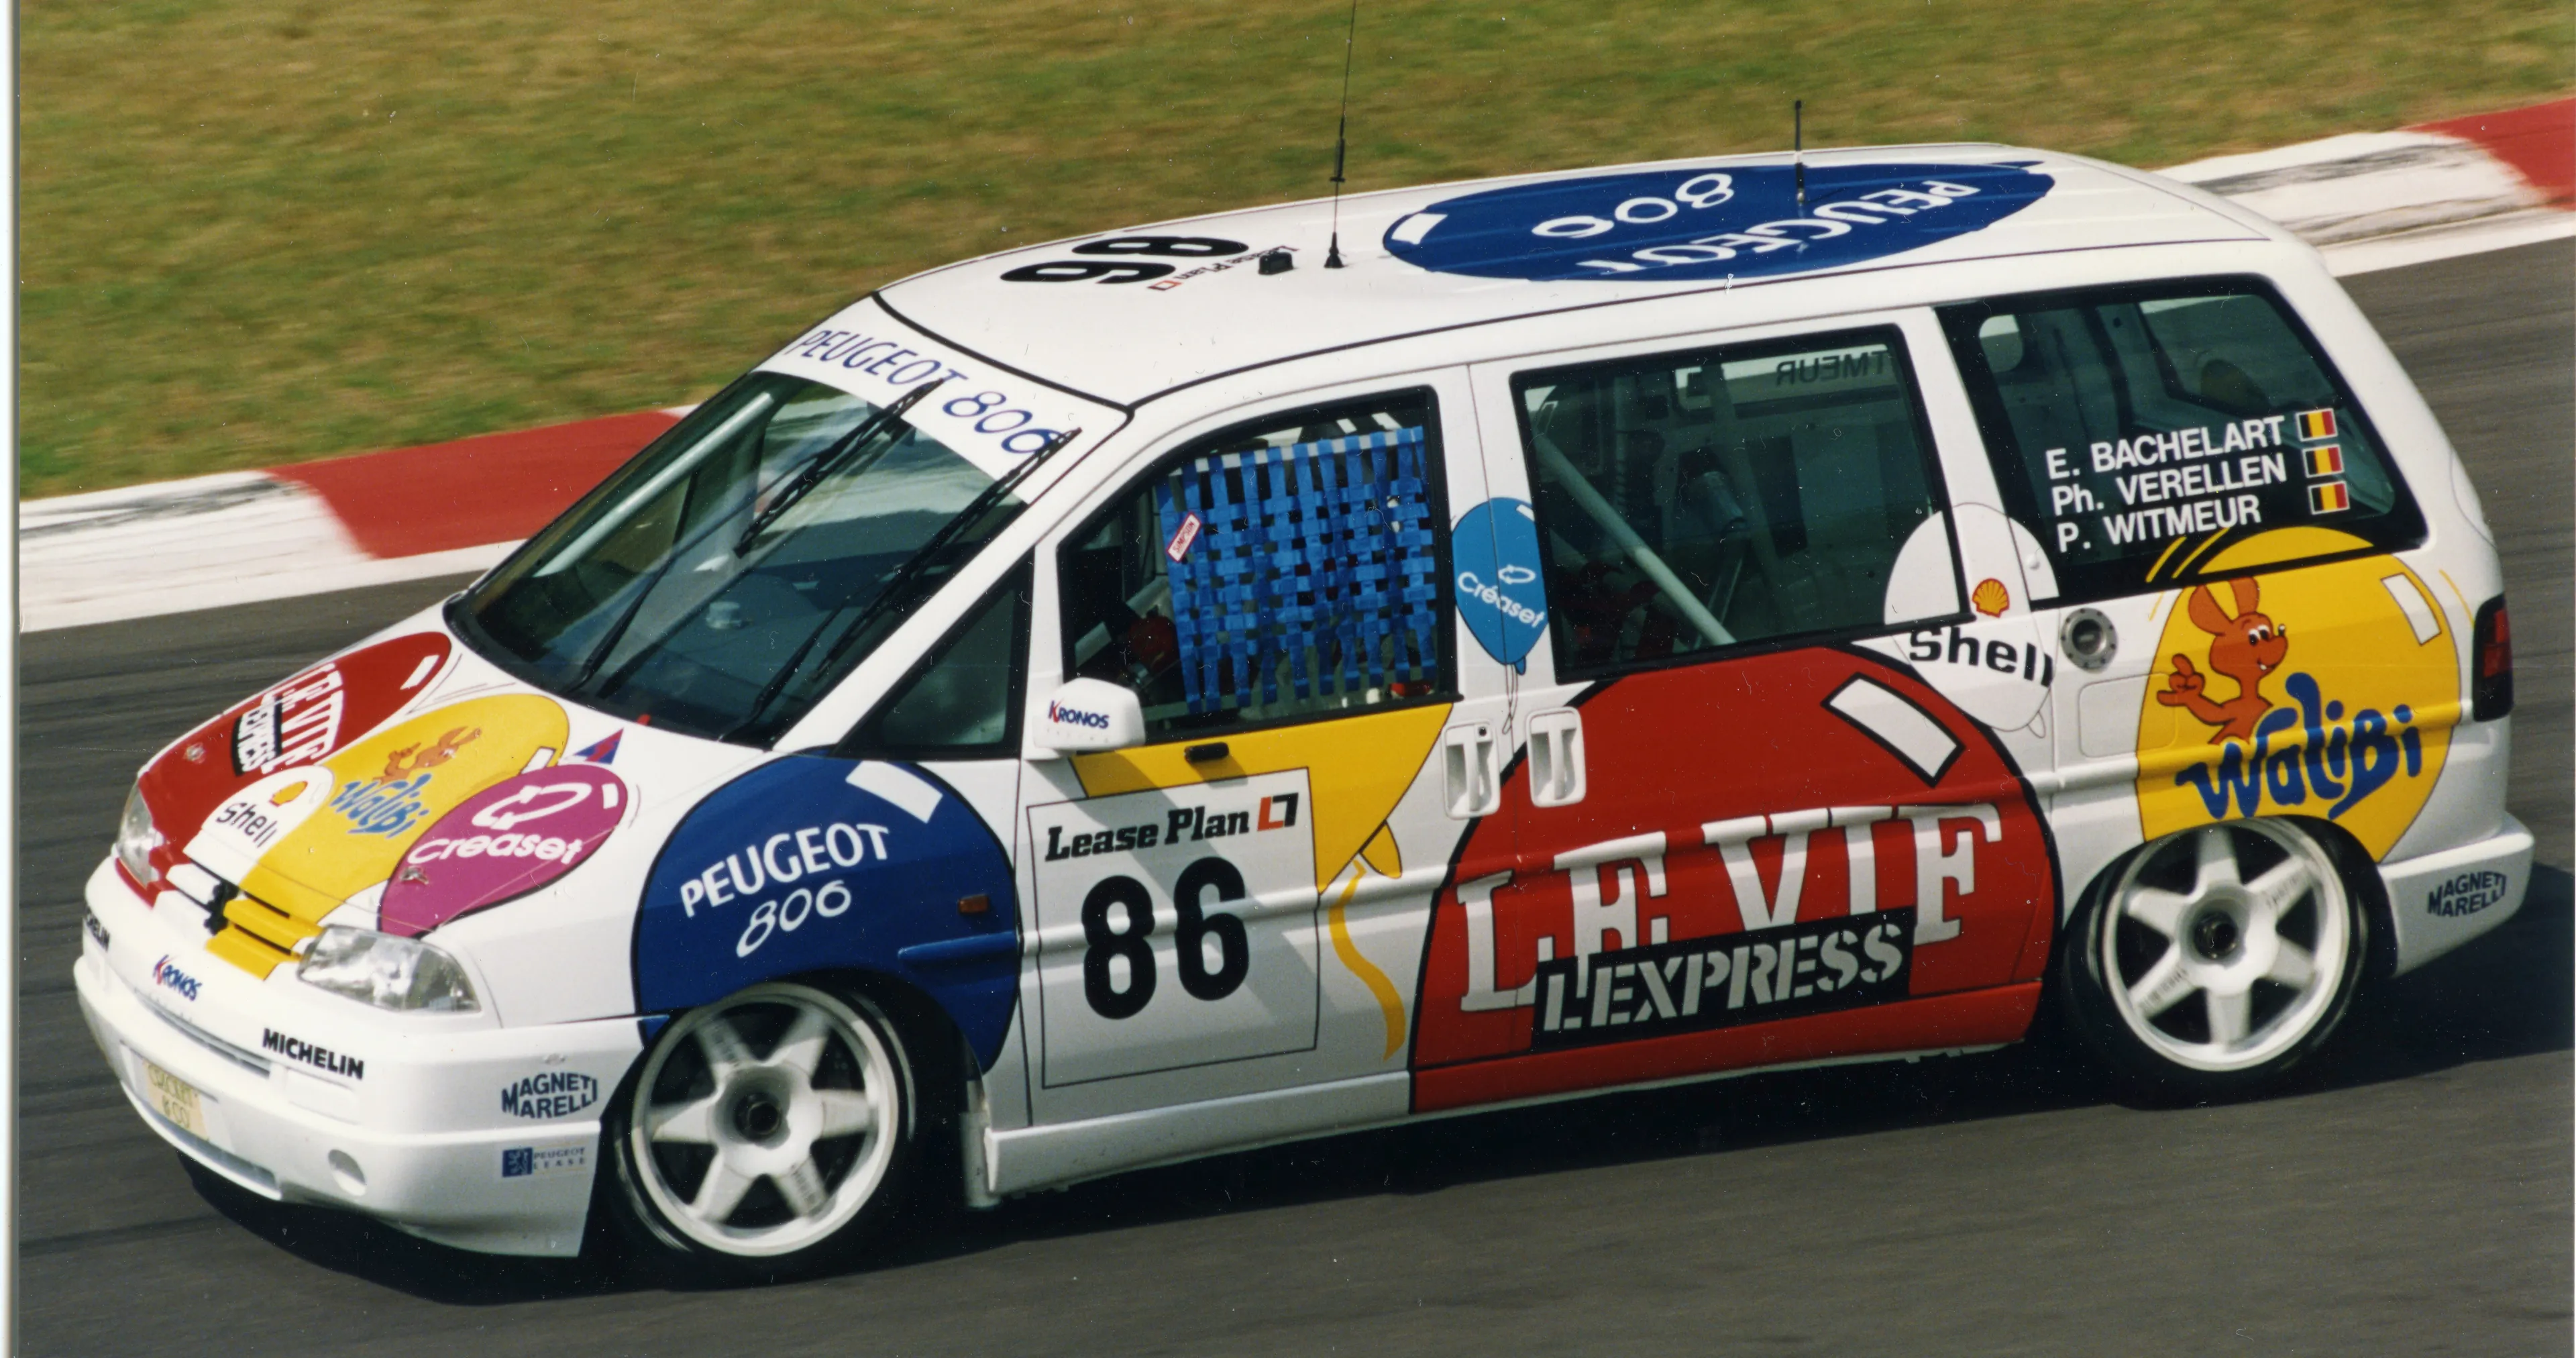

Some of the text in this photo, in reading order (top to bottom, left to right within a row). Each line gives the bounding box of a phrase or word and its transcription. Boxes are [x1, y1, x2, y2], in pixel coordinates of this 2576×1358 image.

[1532, 173, 1734, 239] 806
[784, 329, 1068, 454] PEUGEOT 806
[2046, 415, 2285, 480] E. BACHELART
[2051, 452, 2287, 516] Ph. VERELLEN
[2057, 494, 2261, 553] P. WITMEUR
[1909, 624, 2053, 688] Shell
[215, 802, 278, 848] Shell
[1044, 806, 1250, 862] Lease Plan
[680, 823, 889, 918] PEUGEOT
[736, 880, 852, 958] 806
[1081, 856, 1250, 1021] 86
[1456, 802, 2002, 1012] LE VIF
[262, 1027, 364, 1080] MICHELIN
[534, 1147, 586, 1160] PEUGEOT
